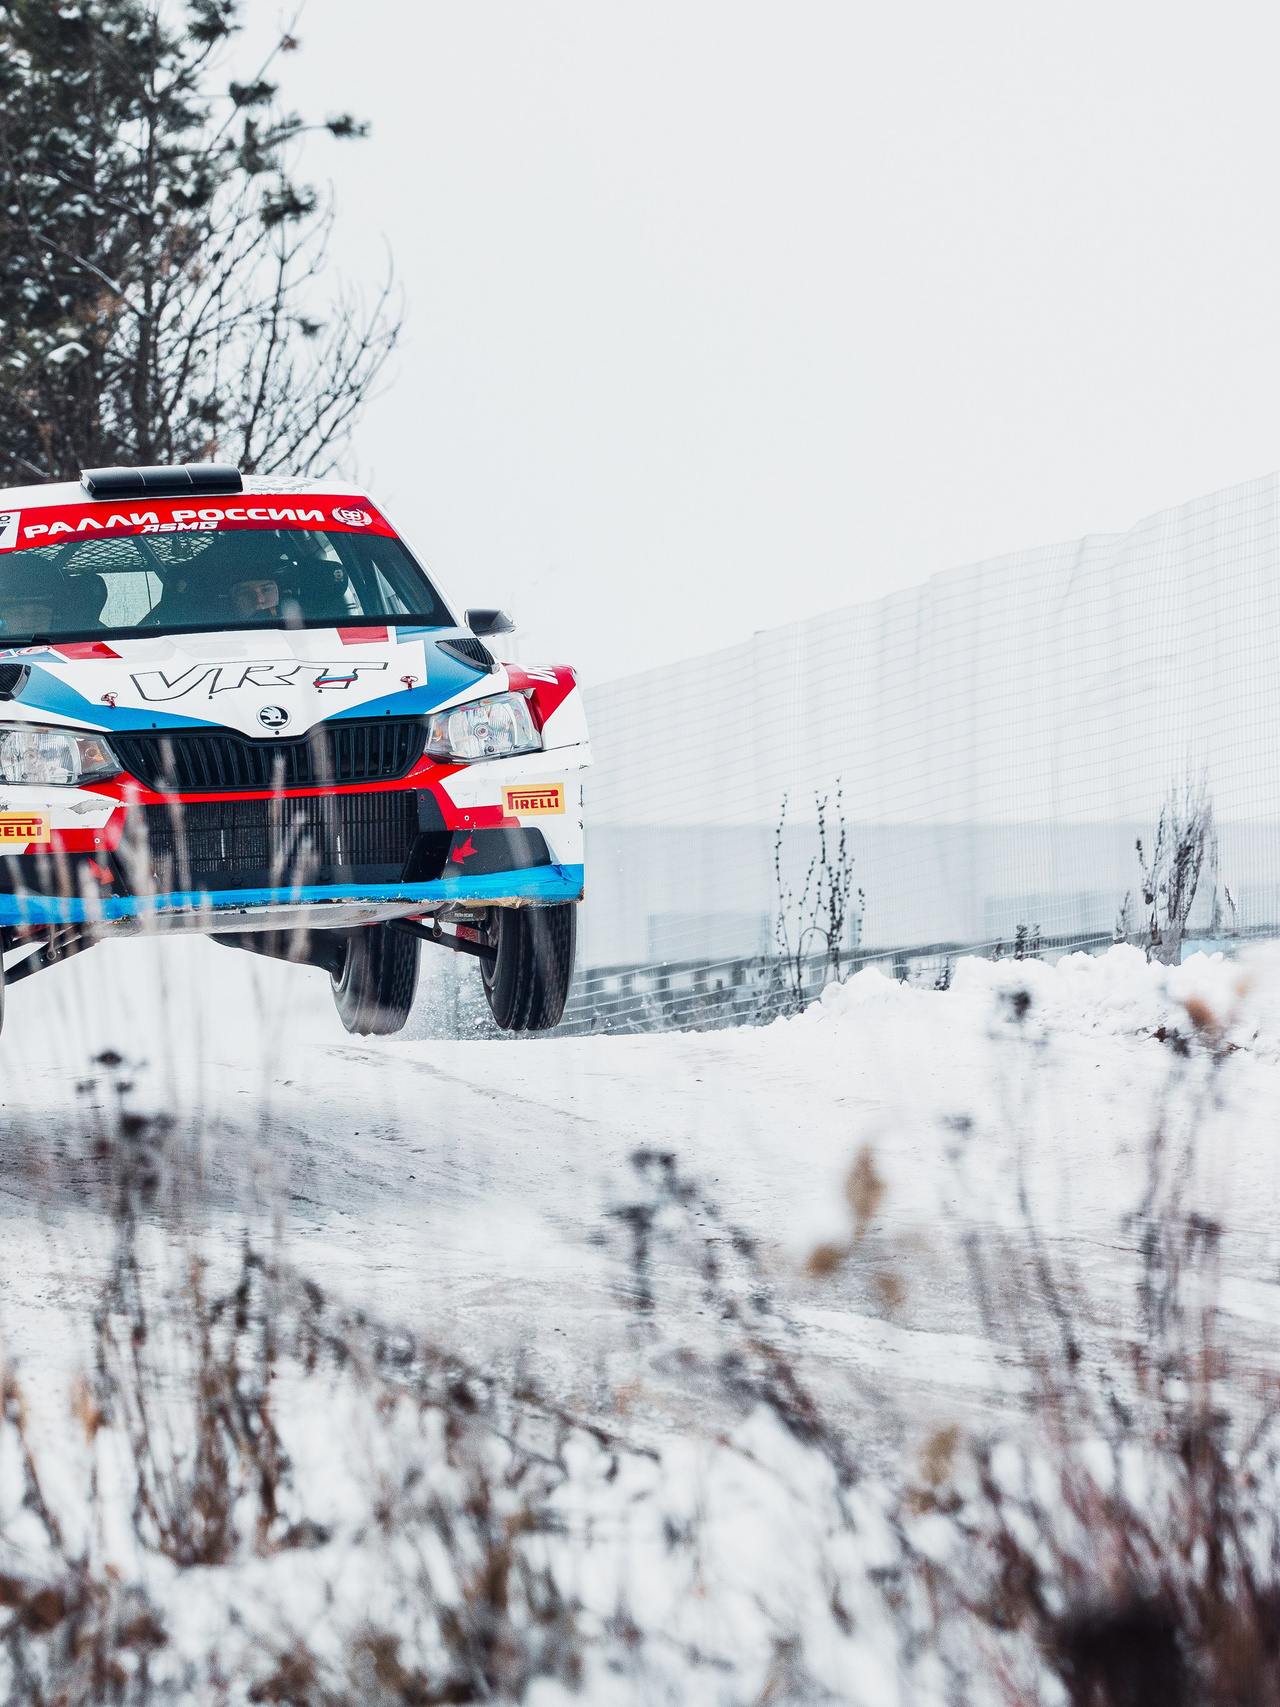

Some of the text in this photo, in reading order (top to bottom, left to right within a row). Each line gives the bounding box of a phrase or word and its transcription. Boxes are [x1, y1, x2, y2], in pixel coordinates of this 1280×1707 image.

[23, 511, 160, 539] РАЛЛИ
[171, 507, 325, 523] РОССИИ
[140, 521, 219, 534] ASMG
[129, 658, 389, 702] VRT
[506, 789, 560, 810] PIRELLI
